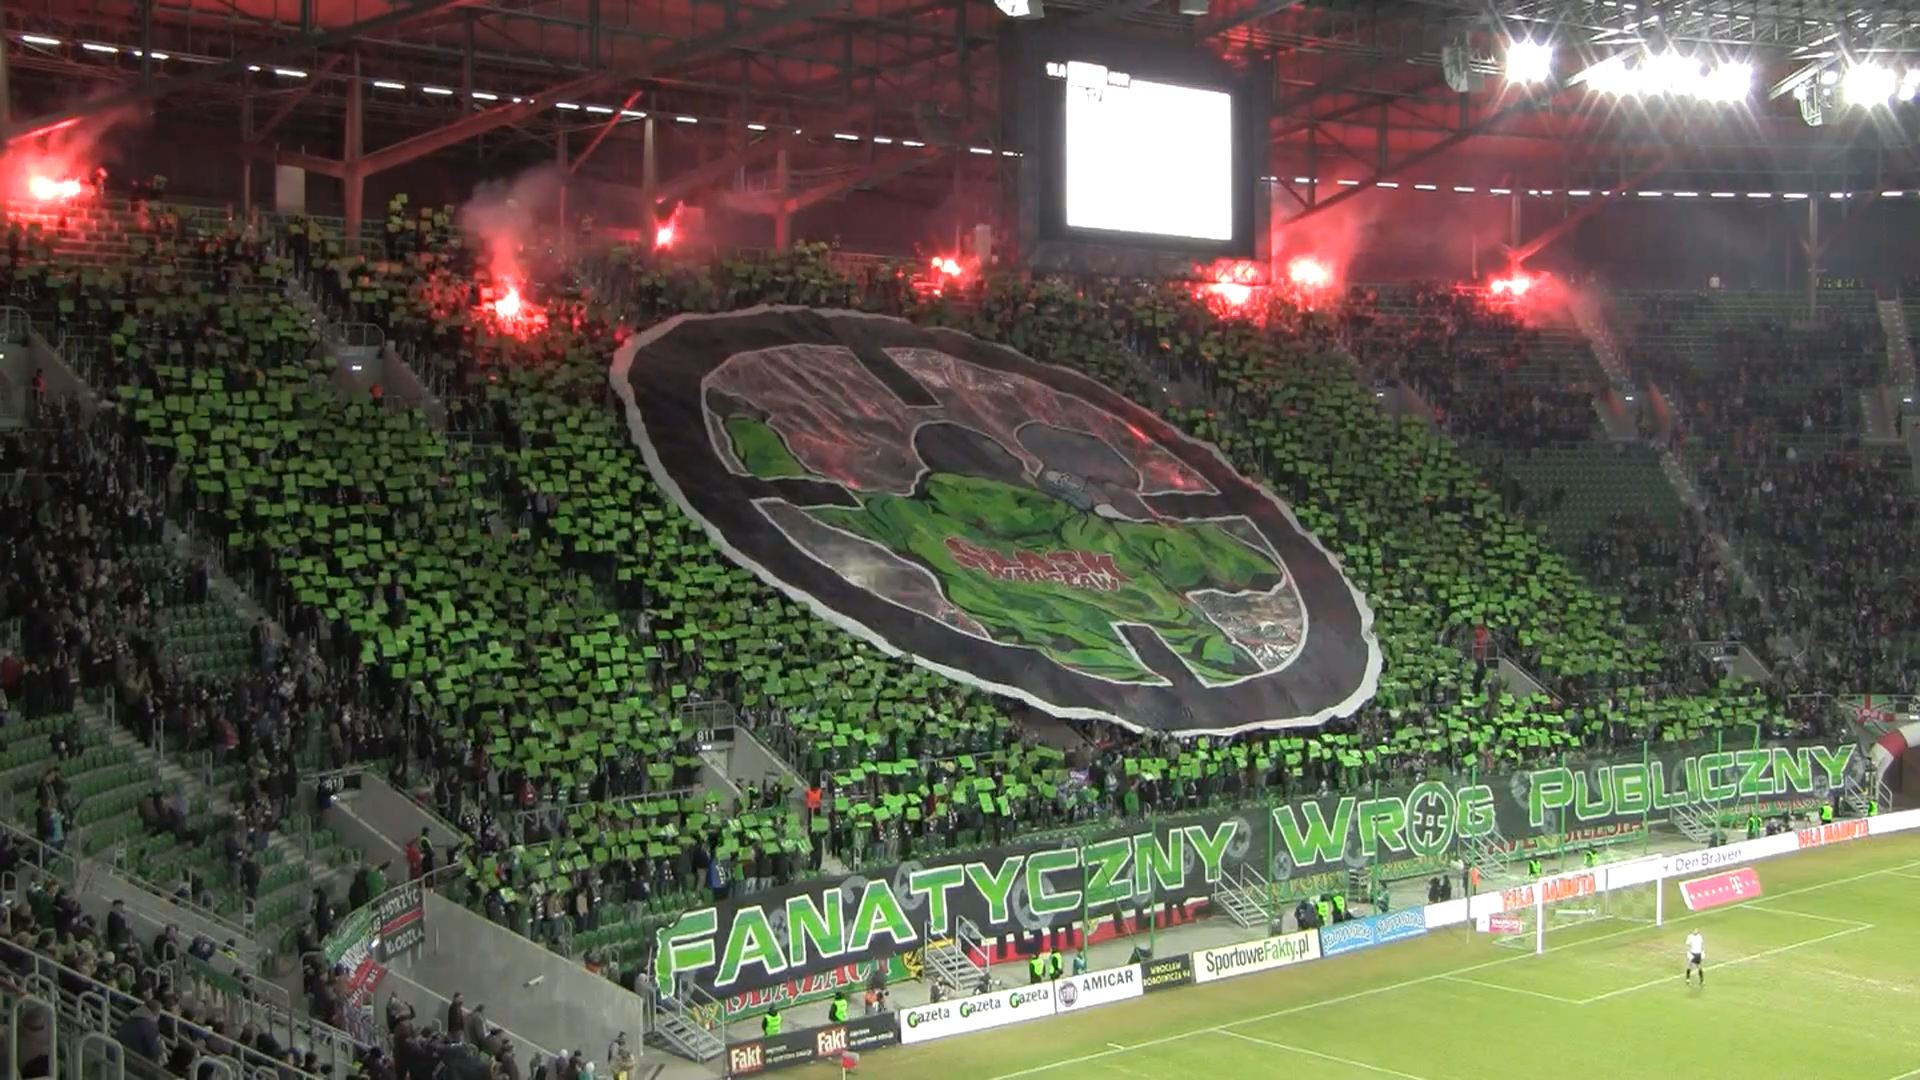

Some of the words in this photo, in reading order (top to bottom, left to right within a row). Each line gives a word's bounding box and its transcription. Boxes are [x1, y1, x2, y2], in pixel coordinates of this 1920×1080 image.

[655, 821, 1238, 999] FANATYCZNY
[1529, 743, 1857, 827] PUBLICZNY
[1675, 857, 1699, 871] Den
[1701, 849, 1742, 866] Braven
[1205, 933, 1310, 976] SportoweFakty.pl
[1083, 969, 1134, 992] AMICAR
[907, 1007, 950, 1028] Gazeta
[959, 998, 1001, 1018] Gazeta
[1009, 988, 1049, 1008] Gazeta
[817, 1028, 847, 1055] Fakt
[730, 1045, 763, 1072] Fakt
